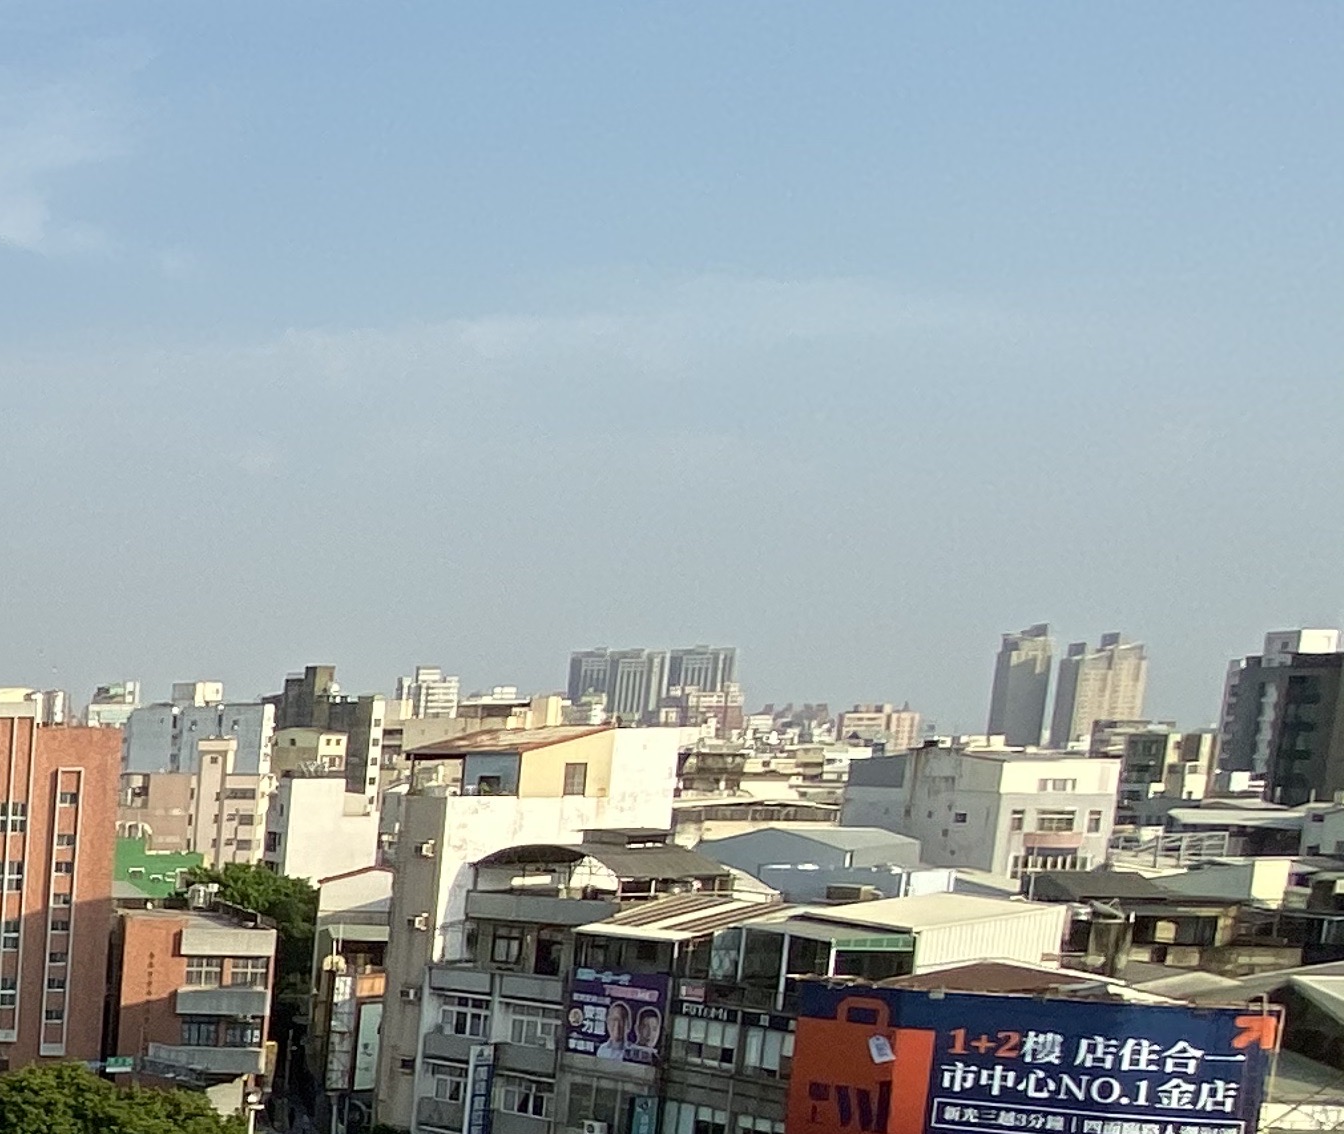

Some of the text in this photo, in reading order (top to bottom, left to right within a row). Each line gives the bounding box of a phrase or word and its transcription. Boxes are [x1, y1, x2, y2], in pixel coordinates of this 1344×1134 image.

[947, 1028, 1246, 1075] 1+2樓 店住合一
[941, 1061, 1240, 1113] 市中心NO.1金店
